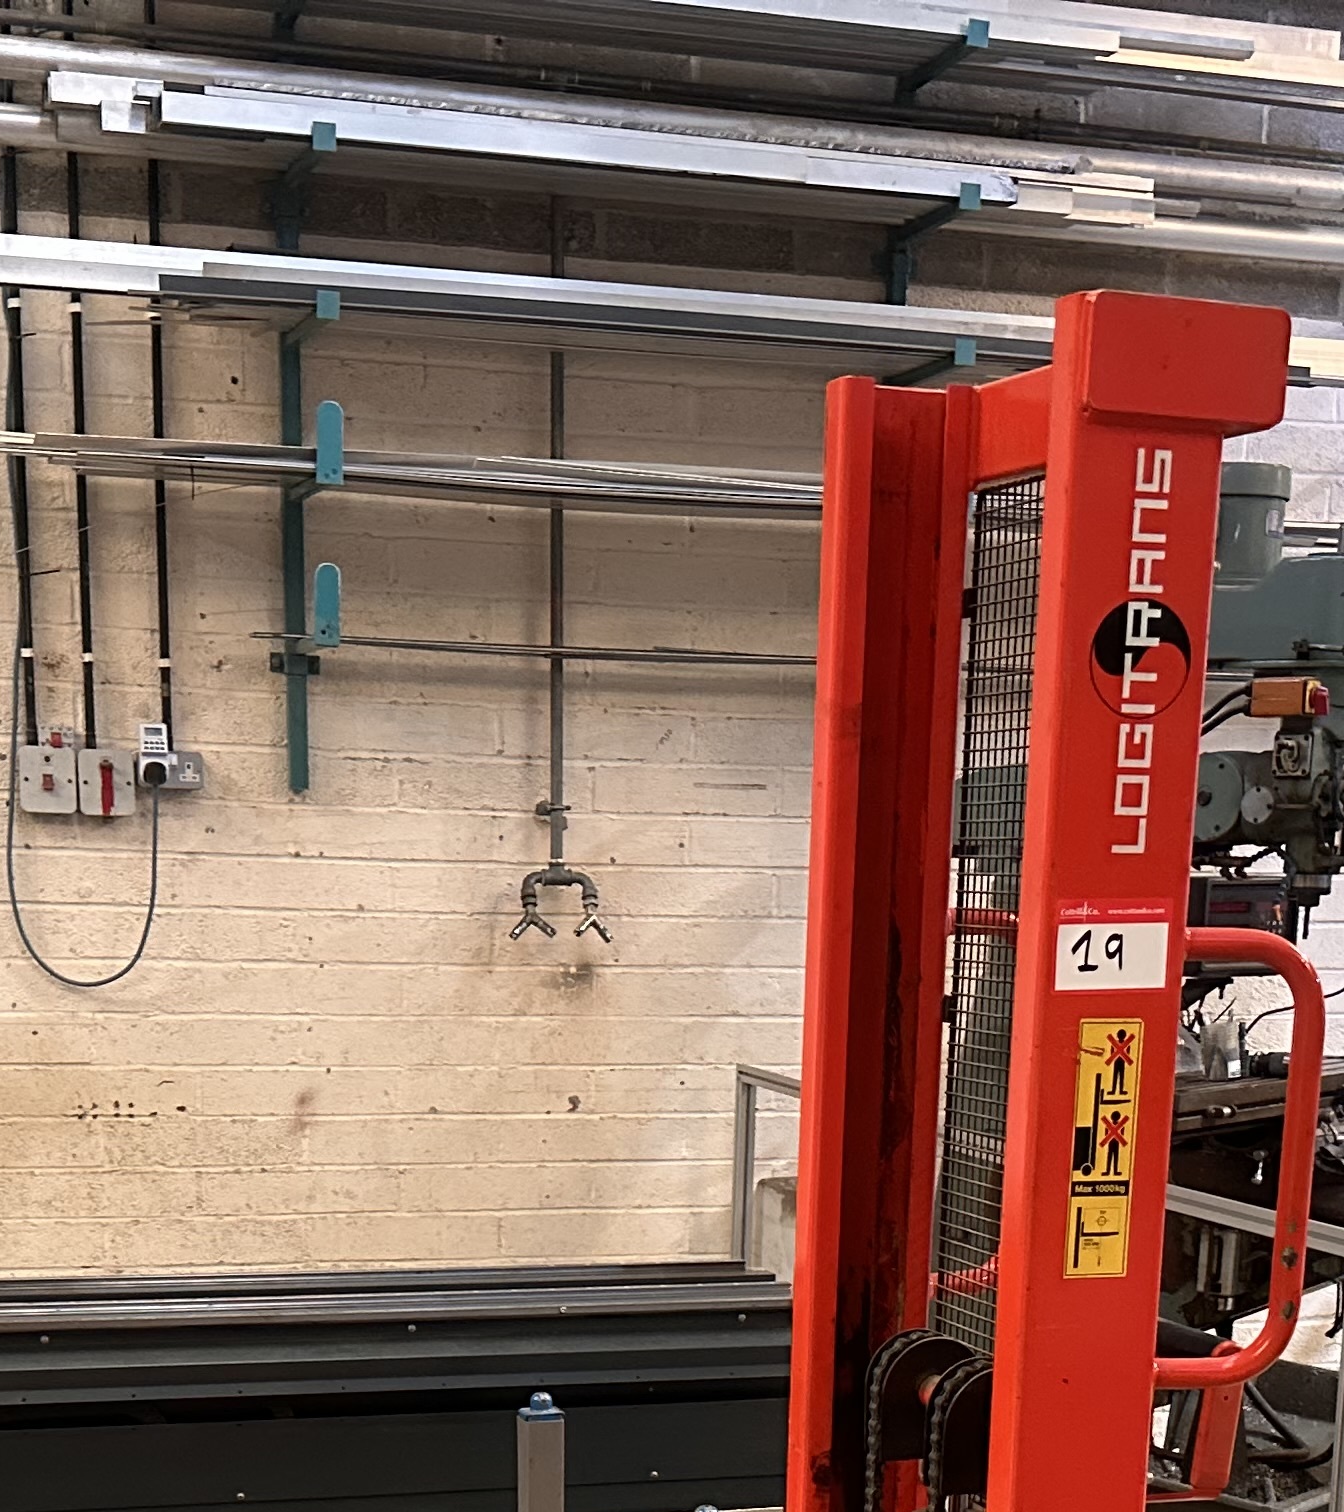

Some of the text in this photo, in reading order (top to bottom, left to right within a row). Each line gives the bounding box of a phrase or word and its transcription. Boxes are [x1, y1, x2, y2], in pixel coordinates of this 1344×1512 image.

[1111, 447, 1173, 854] LOGITRANS
[1071, 929, 1124, 972] 19
[1074, 1184, 1094, 1193] Max
